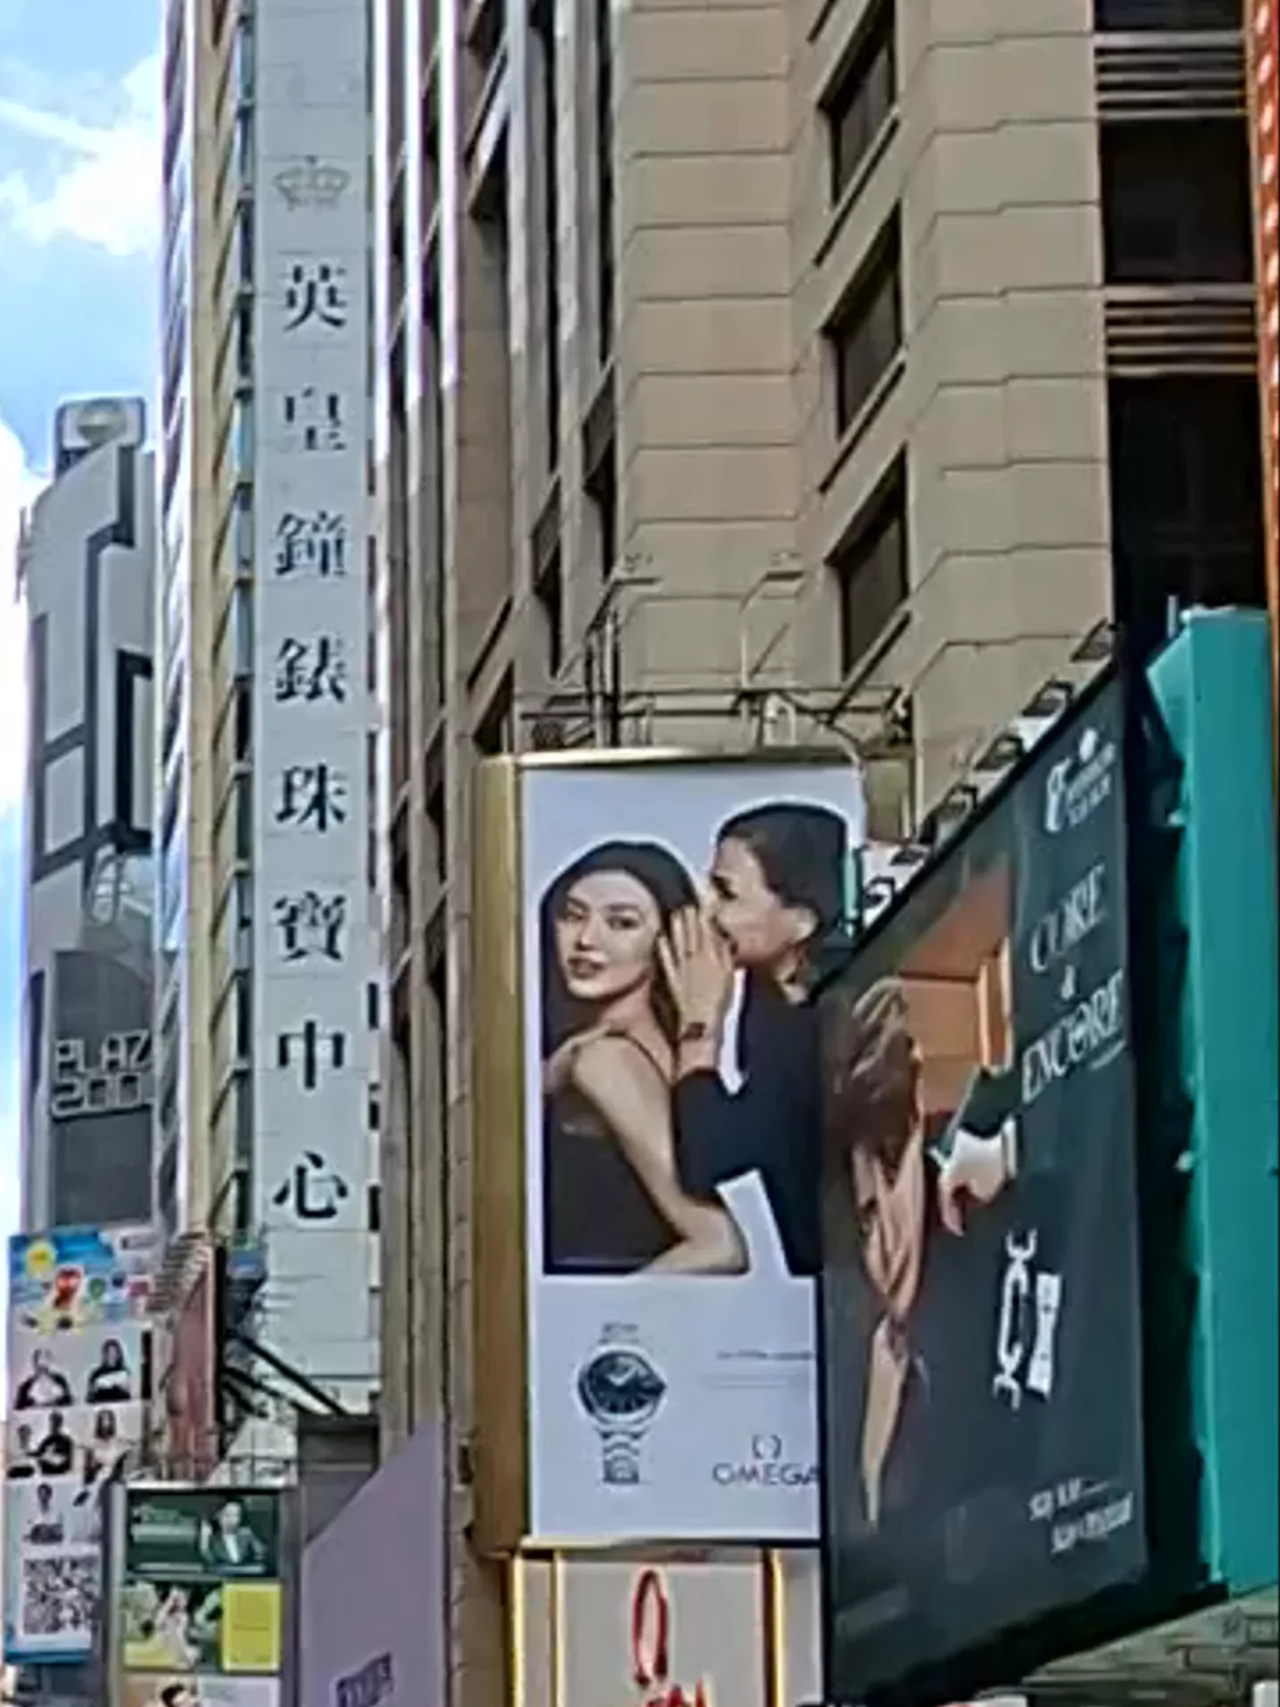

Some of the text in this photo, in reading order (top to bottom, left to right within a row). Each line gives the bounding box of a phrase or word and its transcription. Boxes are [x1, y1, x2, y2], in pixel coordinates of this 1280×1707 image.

[272, 261, 350, 1223] 英皇鐘錶珠寶中心
[712, 1462, 821, 1486] OMEGA
